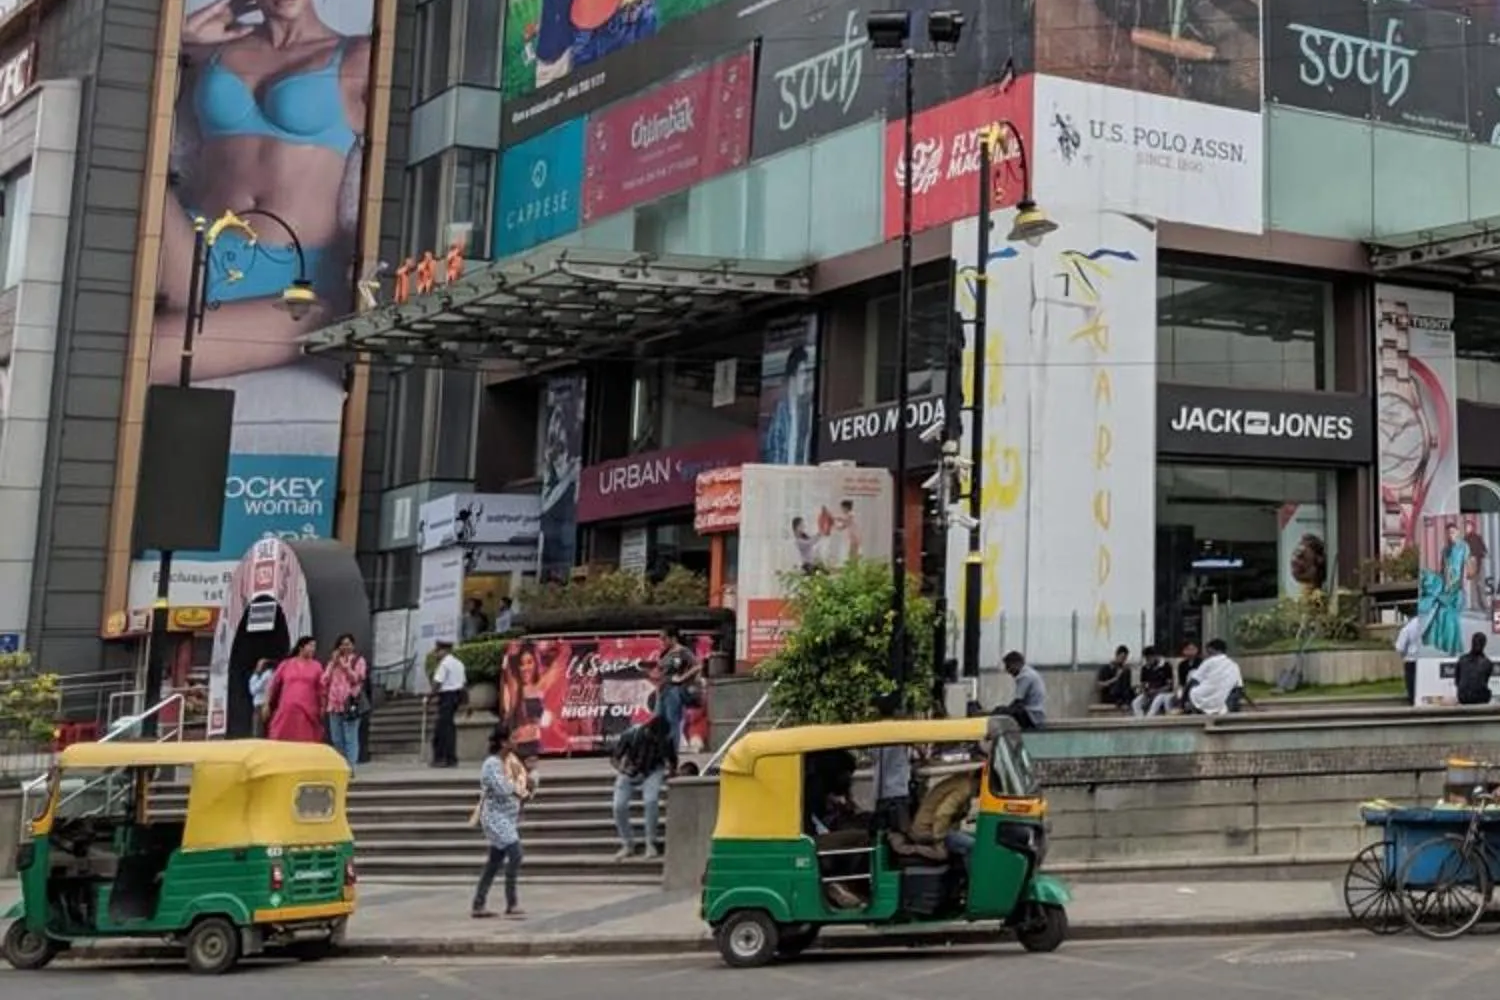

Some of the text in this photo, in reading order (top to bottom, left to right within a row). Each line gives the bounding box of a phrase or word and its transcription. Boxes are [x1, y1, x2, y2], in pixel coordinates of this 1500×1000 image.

[1286, 18, 1418, 107] soch
[1089, 119, 1248, 165] U.S. POLO ASSN.
[828, 412, 880, 443] VERO
[1171, 406, 1354, 440] JACK JONES
[225, 475, 324, 499] OCKEY
[599, 456, 671, 495] URBAN
[244, 498, 323, 517] woman
[152, 570, 219, 586] Eclusive
[561, 702, 642, 719] NIGHT OUT
